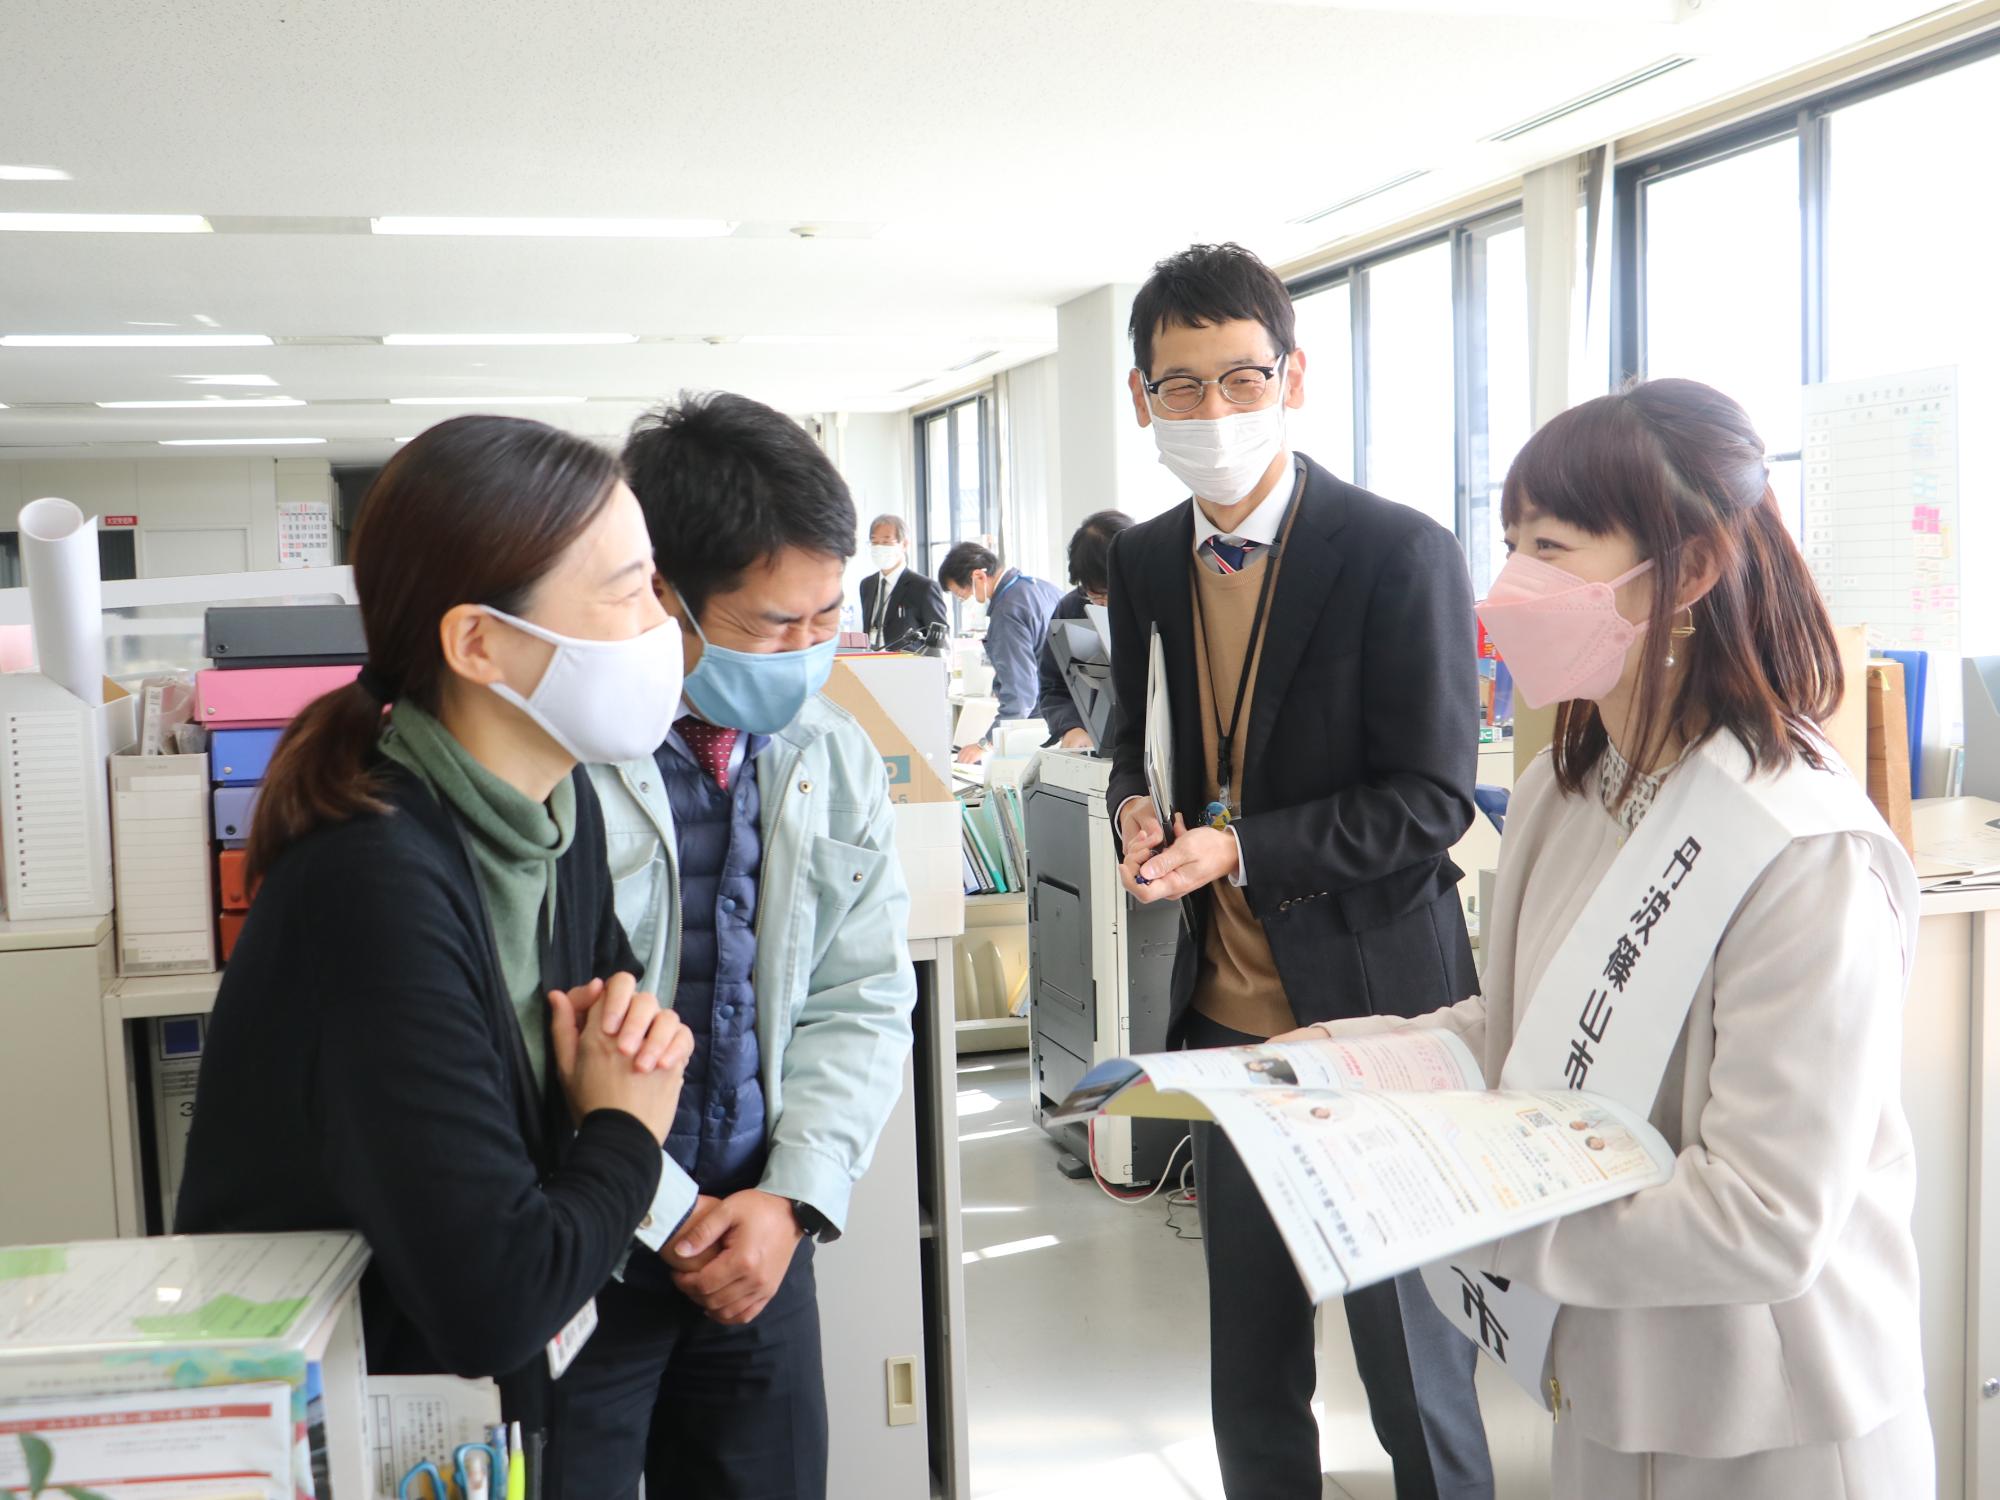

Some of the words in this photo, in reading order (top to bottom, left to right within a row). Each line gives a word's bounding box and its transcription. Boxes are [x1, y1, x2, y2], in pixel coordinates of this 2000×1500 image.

[1563, 836, 1702, 1090] 丹波篠山市
